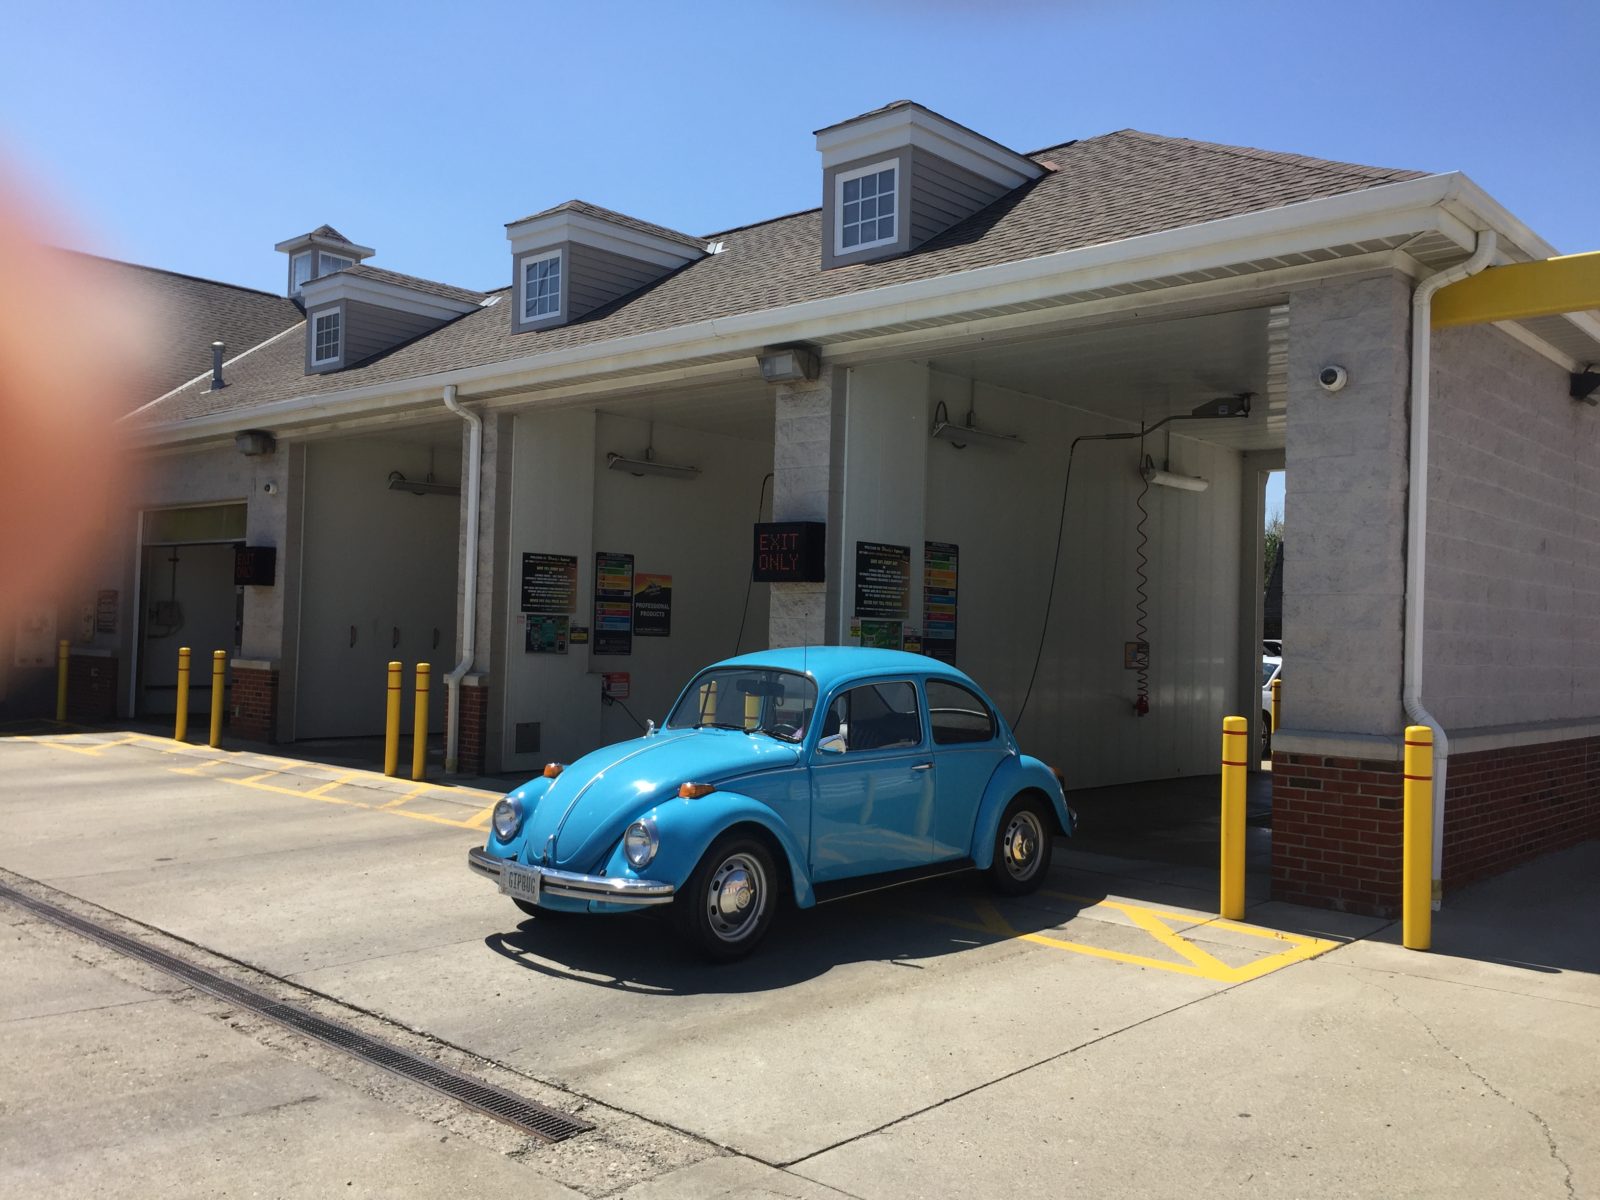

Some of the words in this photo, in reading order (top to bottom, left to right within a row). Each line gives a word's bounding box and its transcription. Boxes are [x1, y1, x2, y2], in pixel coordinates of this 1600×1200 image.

[760, 534, 798, 550] EXIT
[760, 553, 798, 569] ONLY
[635, 602, 670, 610] PROFESSIONAL
